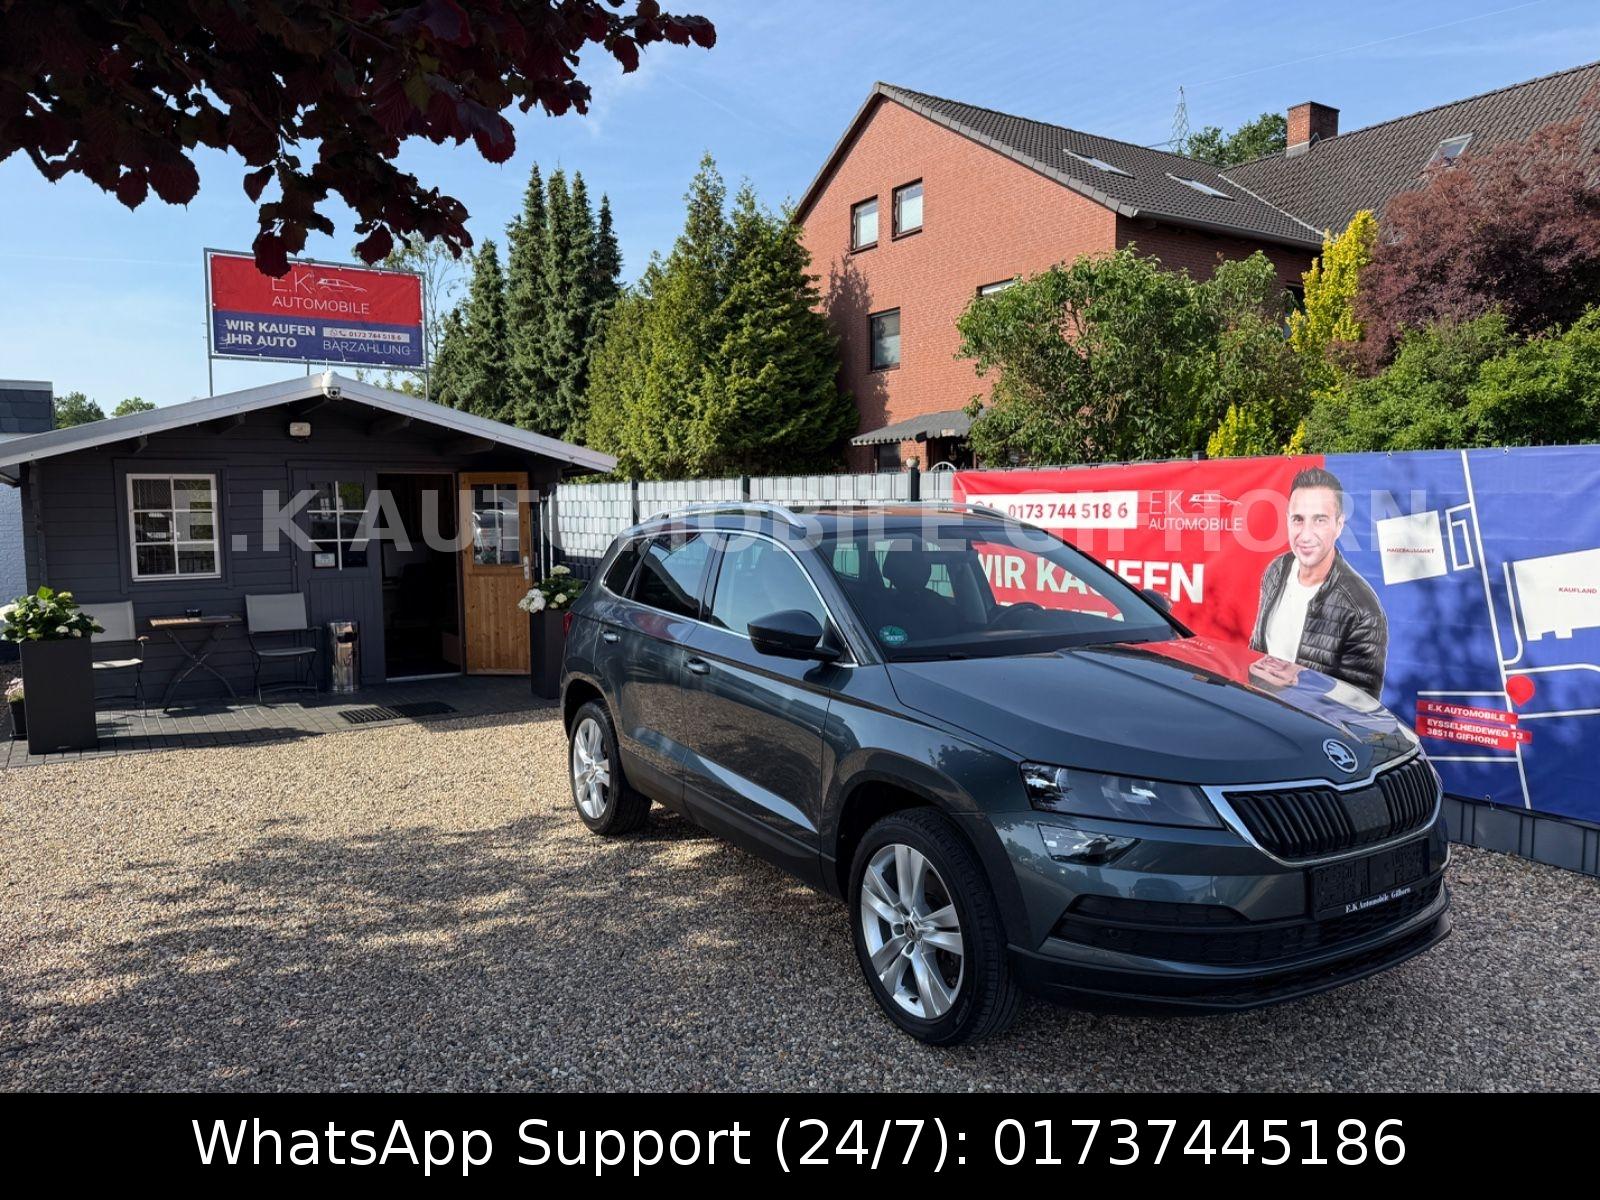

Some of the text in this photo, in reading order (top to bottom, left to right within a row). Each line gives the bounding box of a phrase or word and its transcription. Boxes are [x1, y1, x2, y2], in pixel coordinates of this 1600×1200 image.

[272, 295, 370, 315] AUTOMOBILE
[225, 319, 316, 337] WIR KAUFEN
[226, 333, 297, 349] IHR AUTO
[323, 340, 411, 355] BARZAHLUNG
[1007, 501, 1129, 520] 0173 744 518 6
[1148, 490, 1186, 515] E.K
[1148, 516, 1244, 532] AUTOMOBILE
[1036, 556, 1205, 604] KAFEN
[1557, 586, 1598, 594] KAUFLAND
[1427, 703, 1506, 722] E.K AUTOMOBILE
[1426, 718, 1524, 740] EYSSELHEIDEWEG 13
[1426, 728, 1499, 746] 38518 GIFHORN
